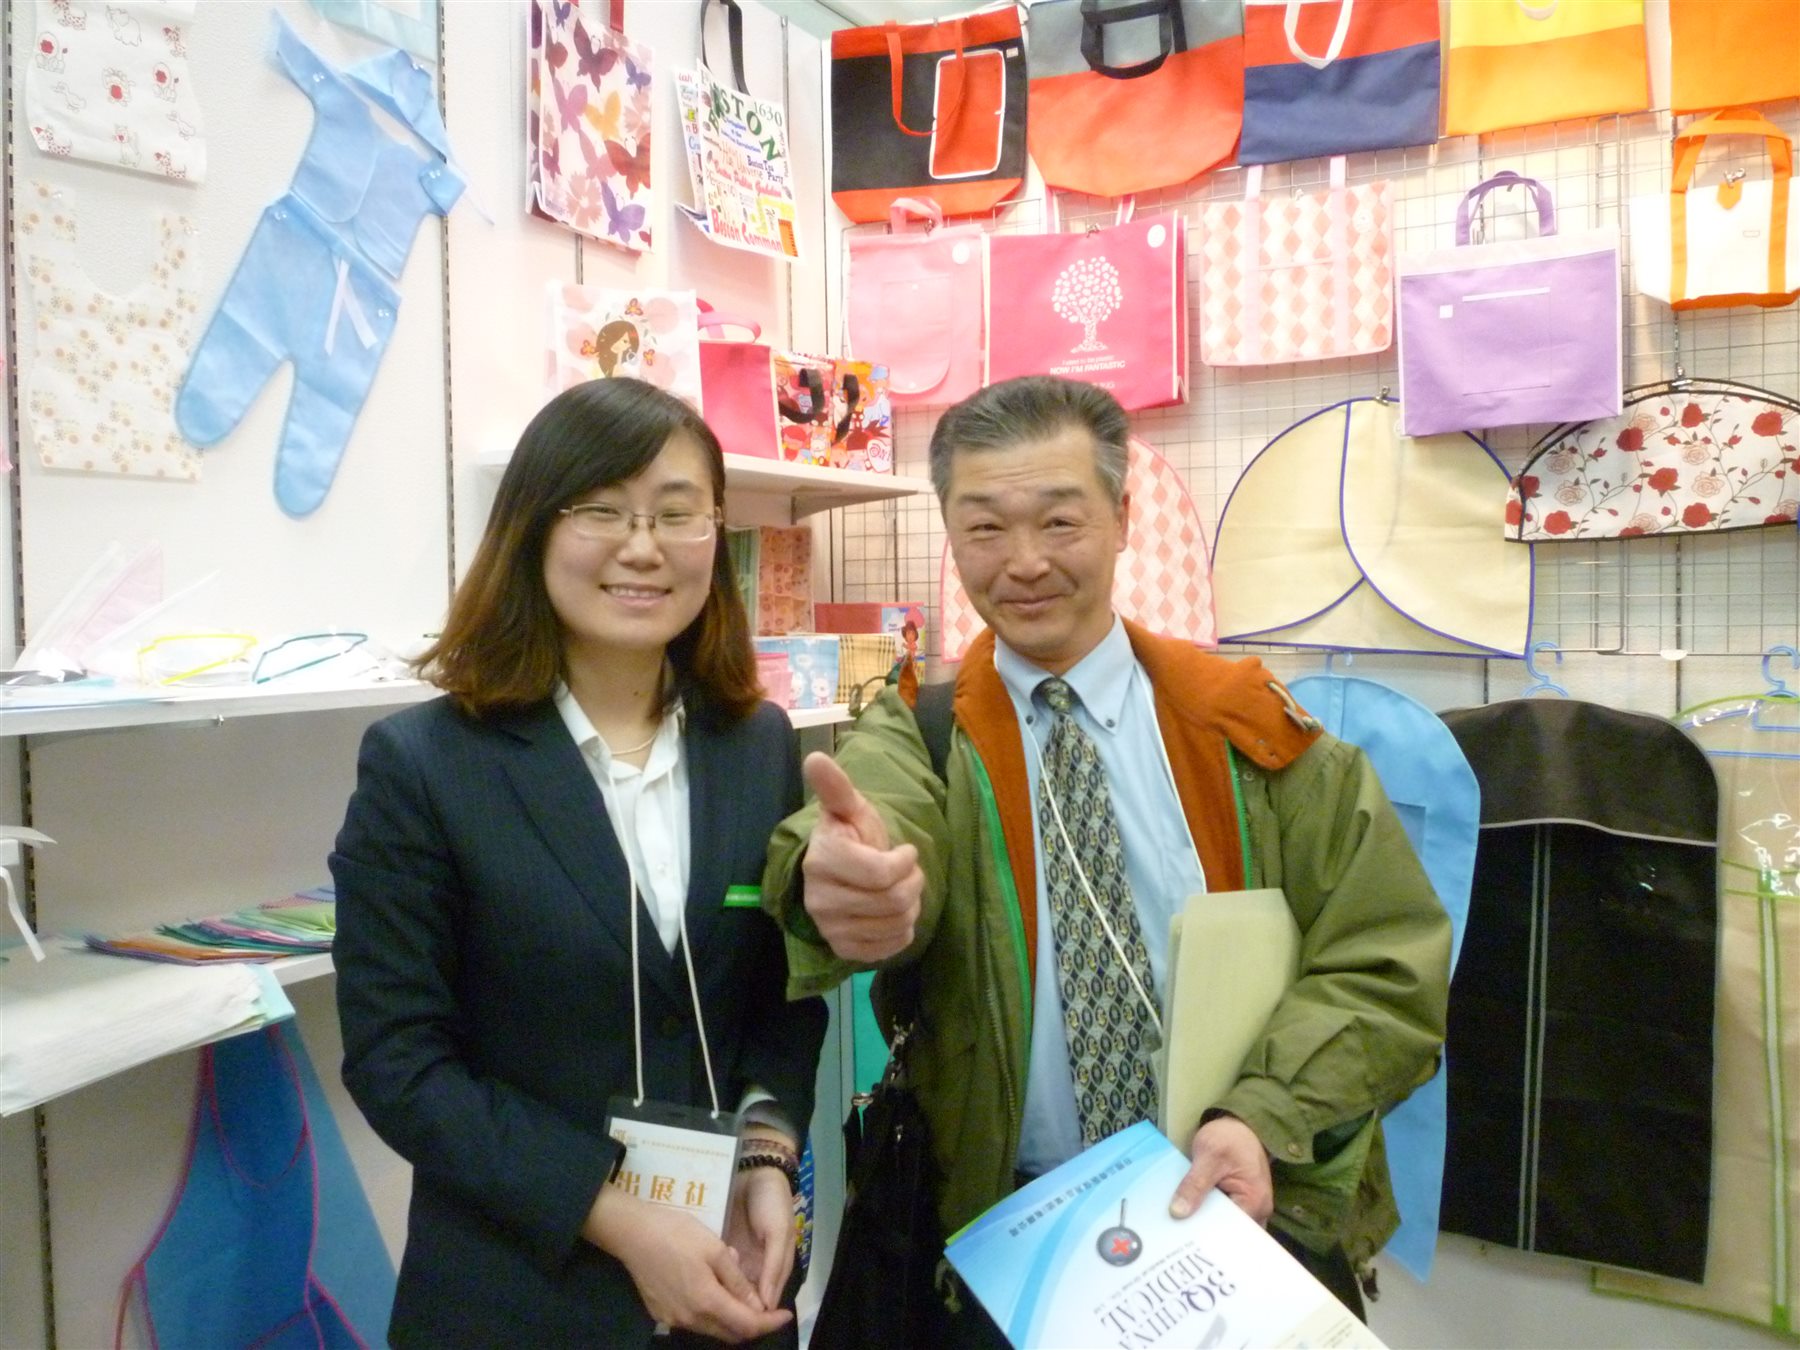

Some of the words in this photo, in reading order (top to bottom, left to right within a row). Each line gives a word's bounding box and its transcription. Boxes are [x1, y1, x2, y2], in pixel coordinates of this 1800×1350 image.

[753, 101, 783, 127] 1630
[711, 209, 742, 243] Boston
[742, 223, 783, 253] Common
[1050, 366, 1071, 376] NOW
[1071, 364, 1084, 374] I'M
[1084, 360, 1126, 371] FANTASTIC
[1100, 1248, 1214, 1334] MEDICAL
